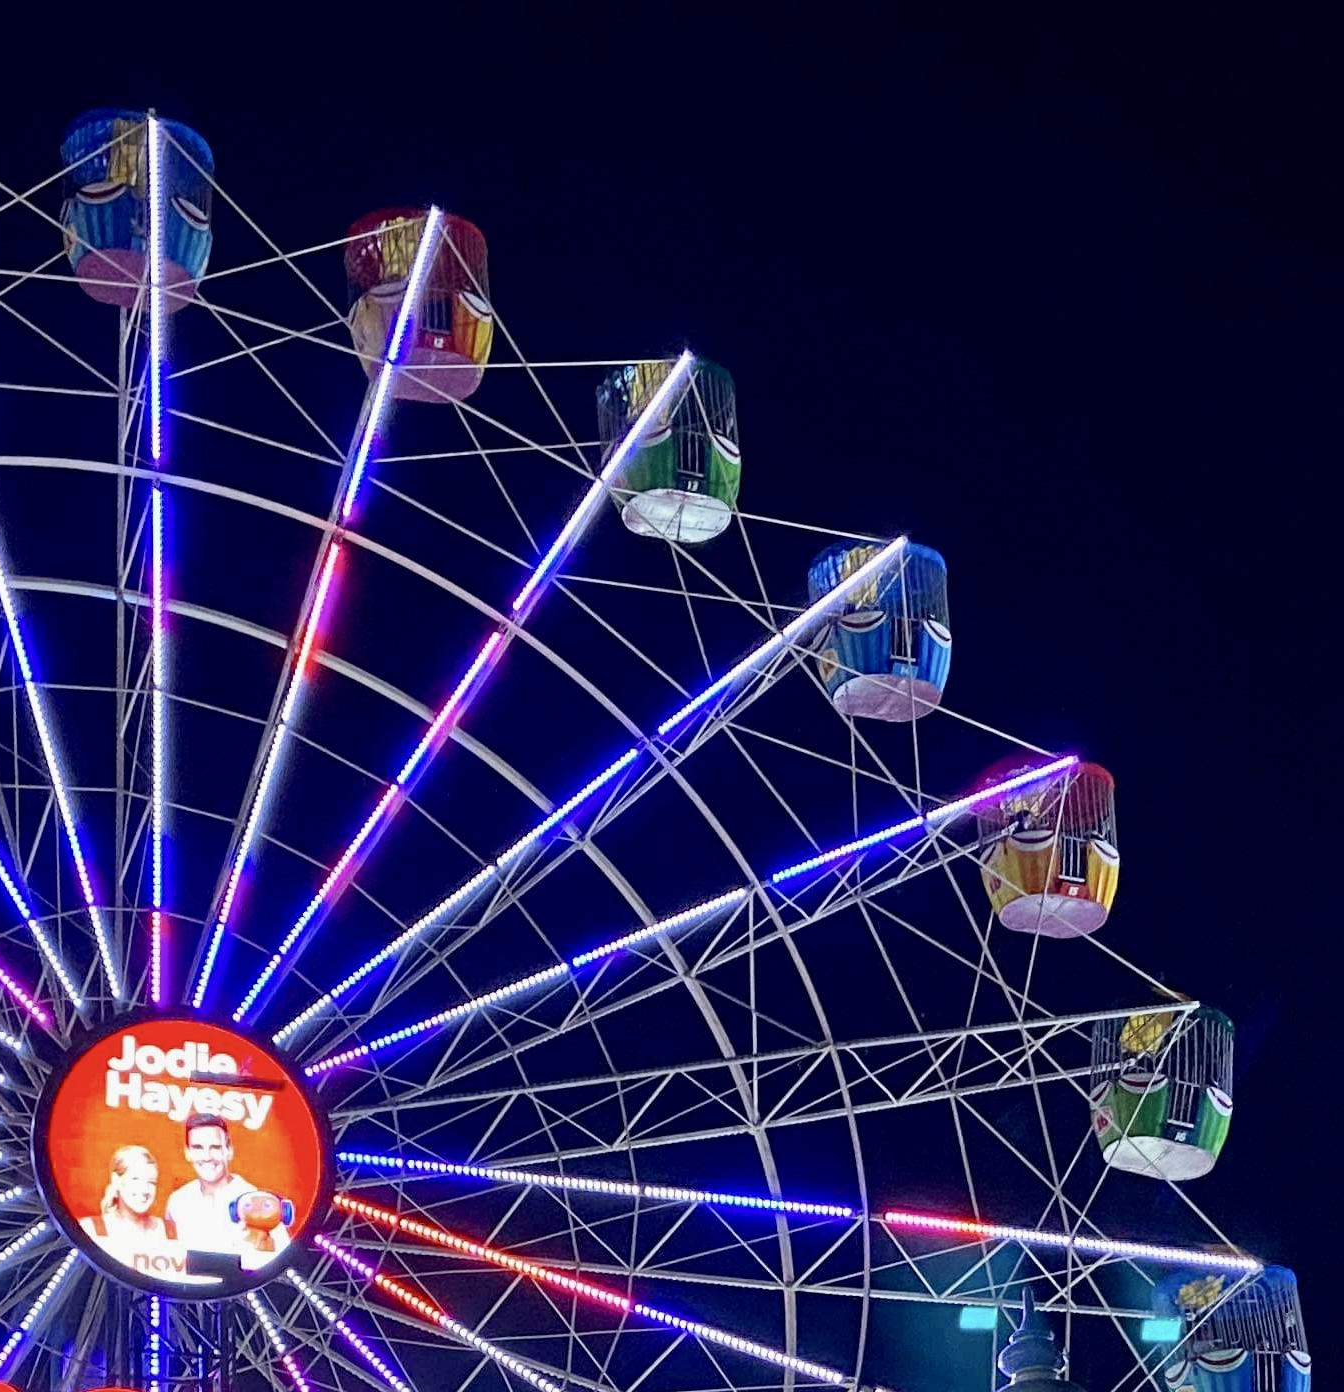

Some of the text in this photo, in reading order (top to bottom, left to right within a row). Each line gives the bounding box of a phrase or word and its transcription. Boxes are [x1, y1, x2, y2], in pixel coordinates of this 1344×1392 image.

[108, 1035, 237, 1078] Jodie
[105, 1069, 273, 1130] Hayesy
[133, 1253, 187, 1273] nov
